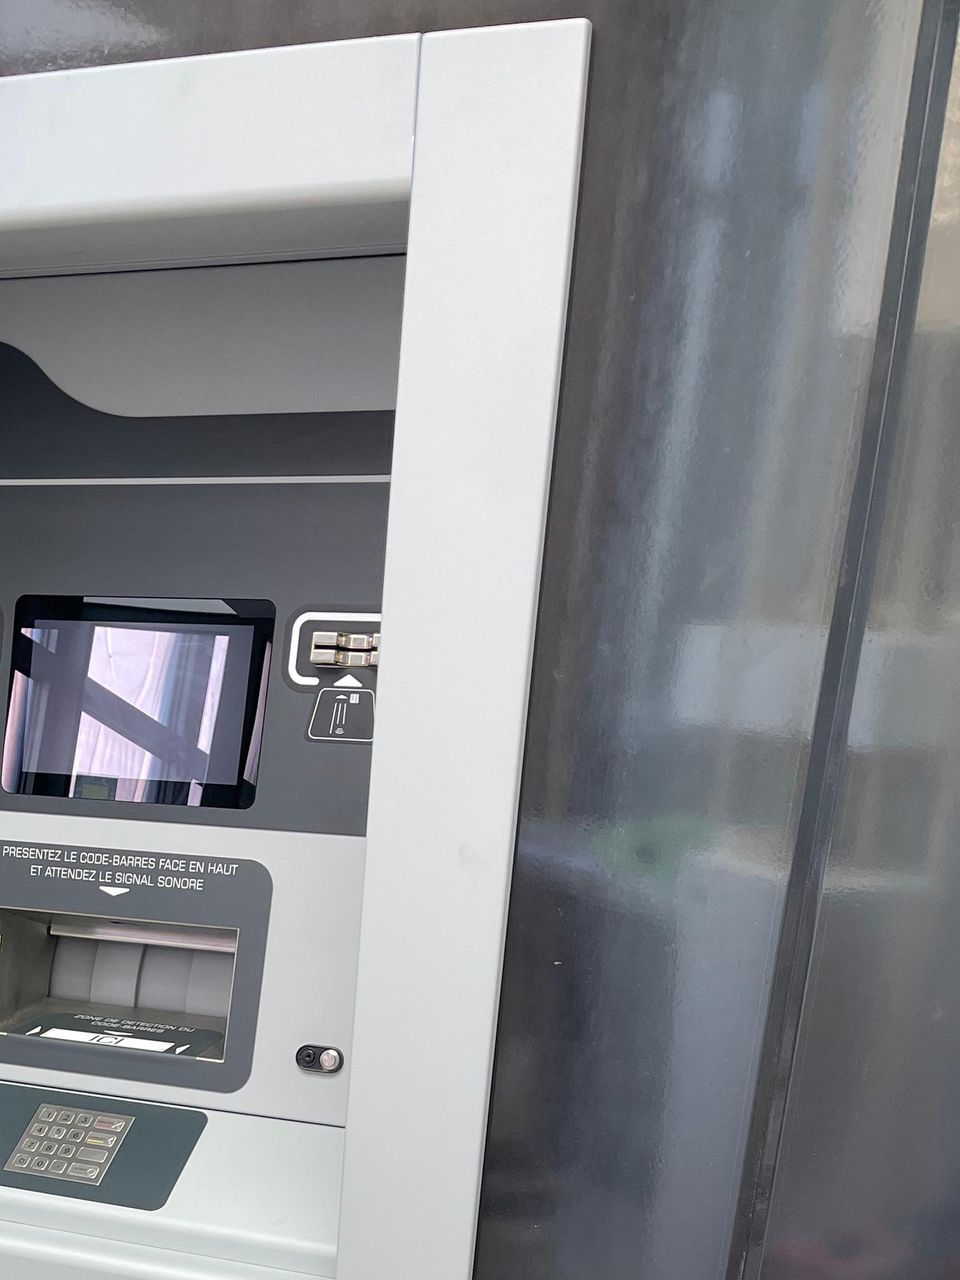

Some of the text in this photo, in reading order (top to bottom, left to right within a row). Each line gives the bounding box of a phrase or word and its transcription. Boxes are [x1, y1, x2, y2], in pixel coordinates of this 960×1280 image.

[2, 845, 238, 876] PRESENTEZ LE CODE-BARRES FACE EN HAUT
[30, 865, 204, 891] ET ATTENDEZ LE SIGNAL SONORE
[73, 1014, 103, 1022] ZONE
[121, 1018, 177, 1031] DETECTION
[91, 1020, 166, 1034] CODE-BARRES
[89, 1034, 125, 1045] ICI
